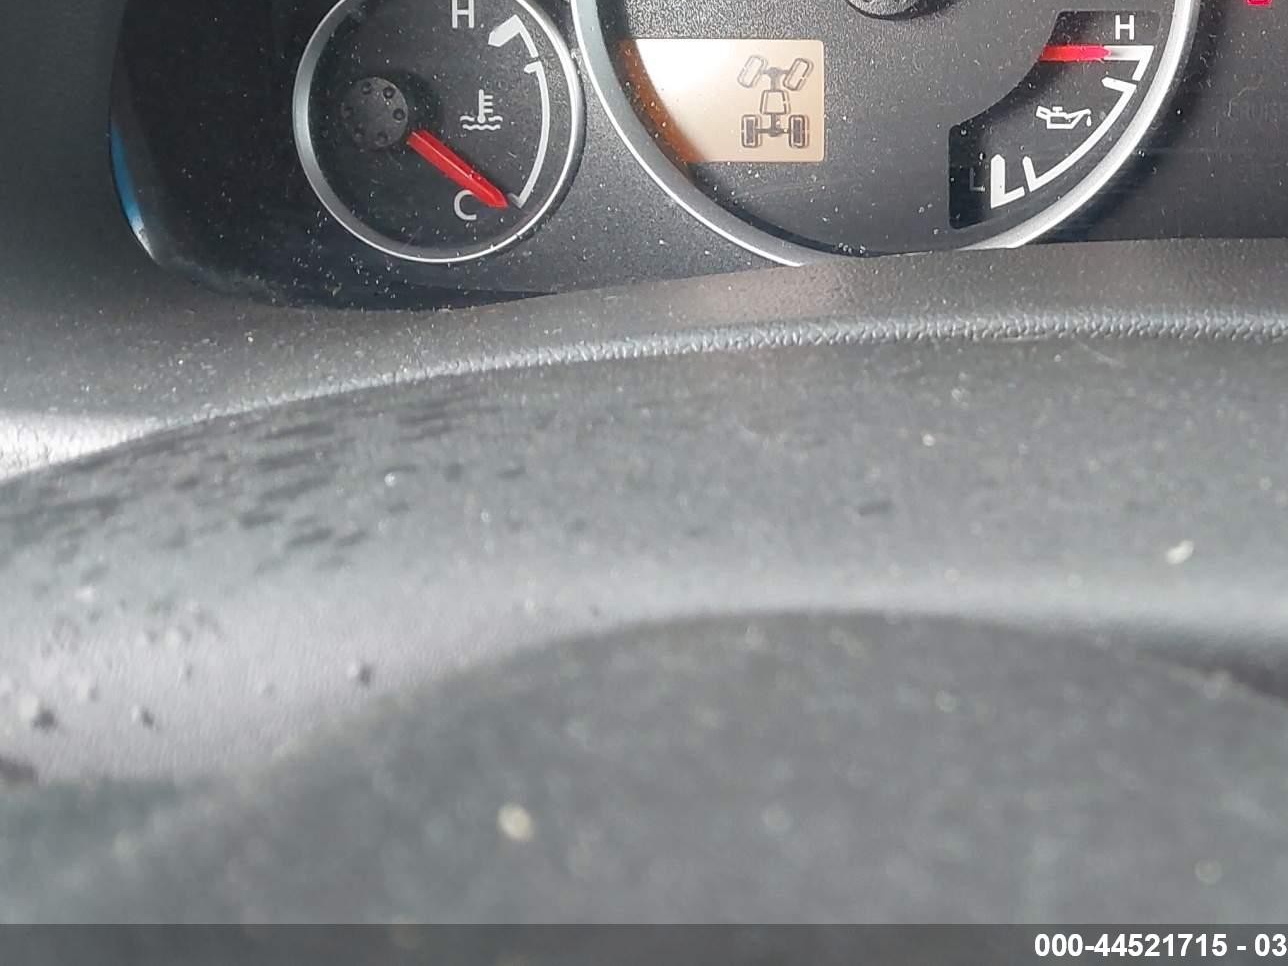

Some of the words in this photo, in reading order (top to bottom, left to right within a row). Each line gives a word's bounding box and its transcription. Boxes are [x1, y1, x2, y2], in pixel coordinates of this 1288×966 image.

[1115, 14, 1135, 40] H
[969, 167, 986, 192] L
[453, 189, 477, 221] C
